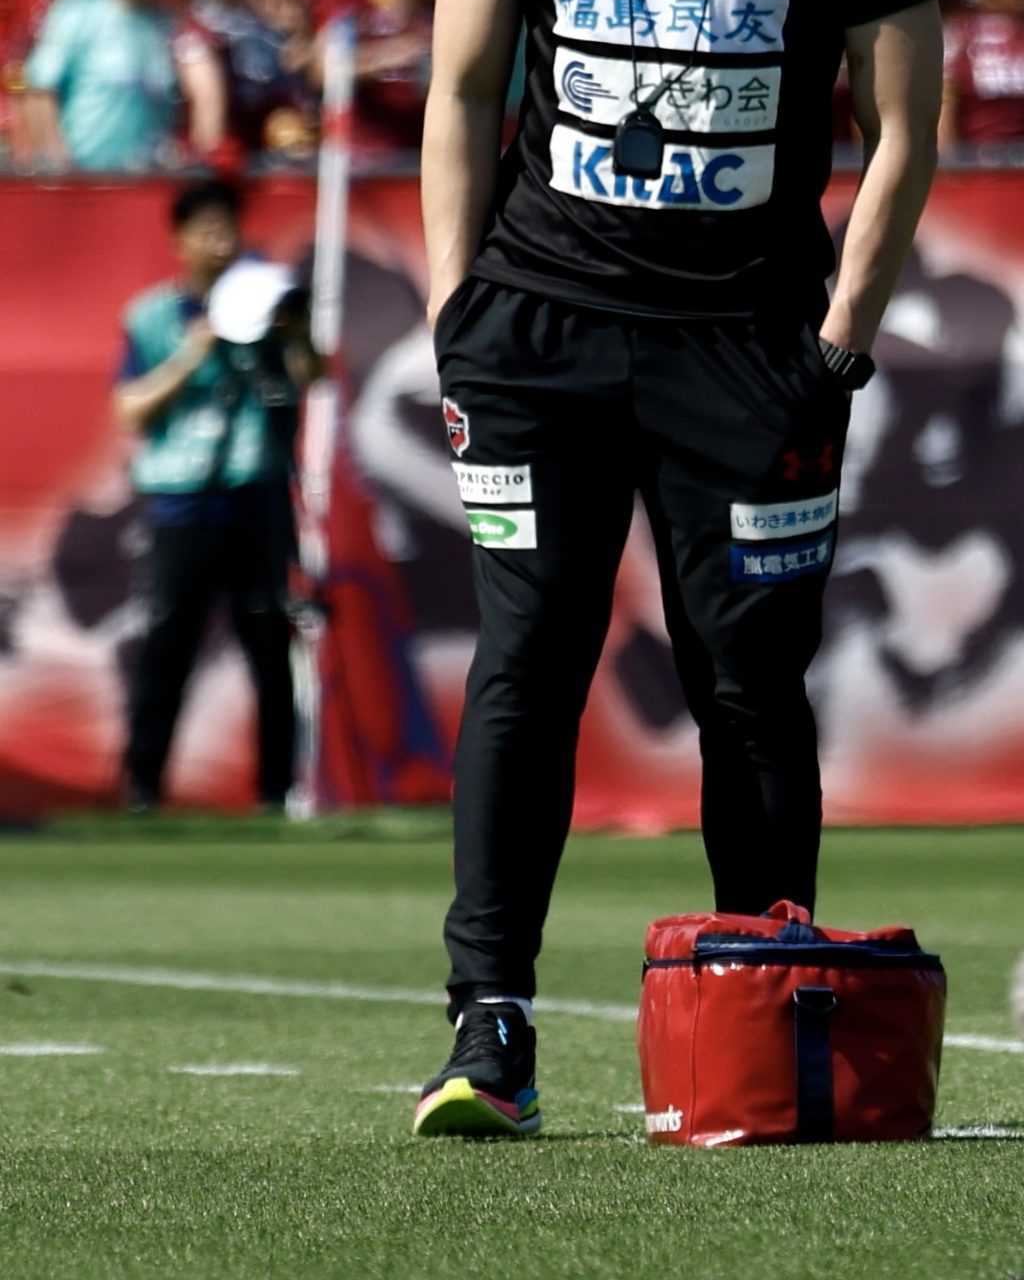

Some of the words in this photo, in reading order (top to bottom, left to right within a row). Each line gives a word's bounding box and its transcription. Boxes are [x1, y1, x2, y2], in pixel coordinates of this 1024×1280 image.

[629, 72, 771, 113] ときわ会
[457, 472, 525, 486] PRICCIO
